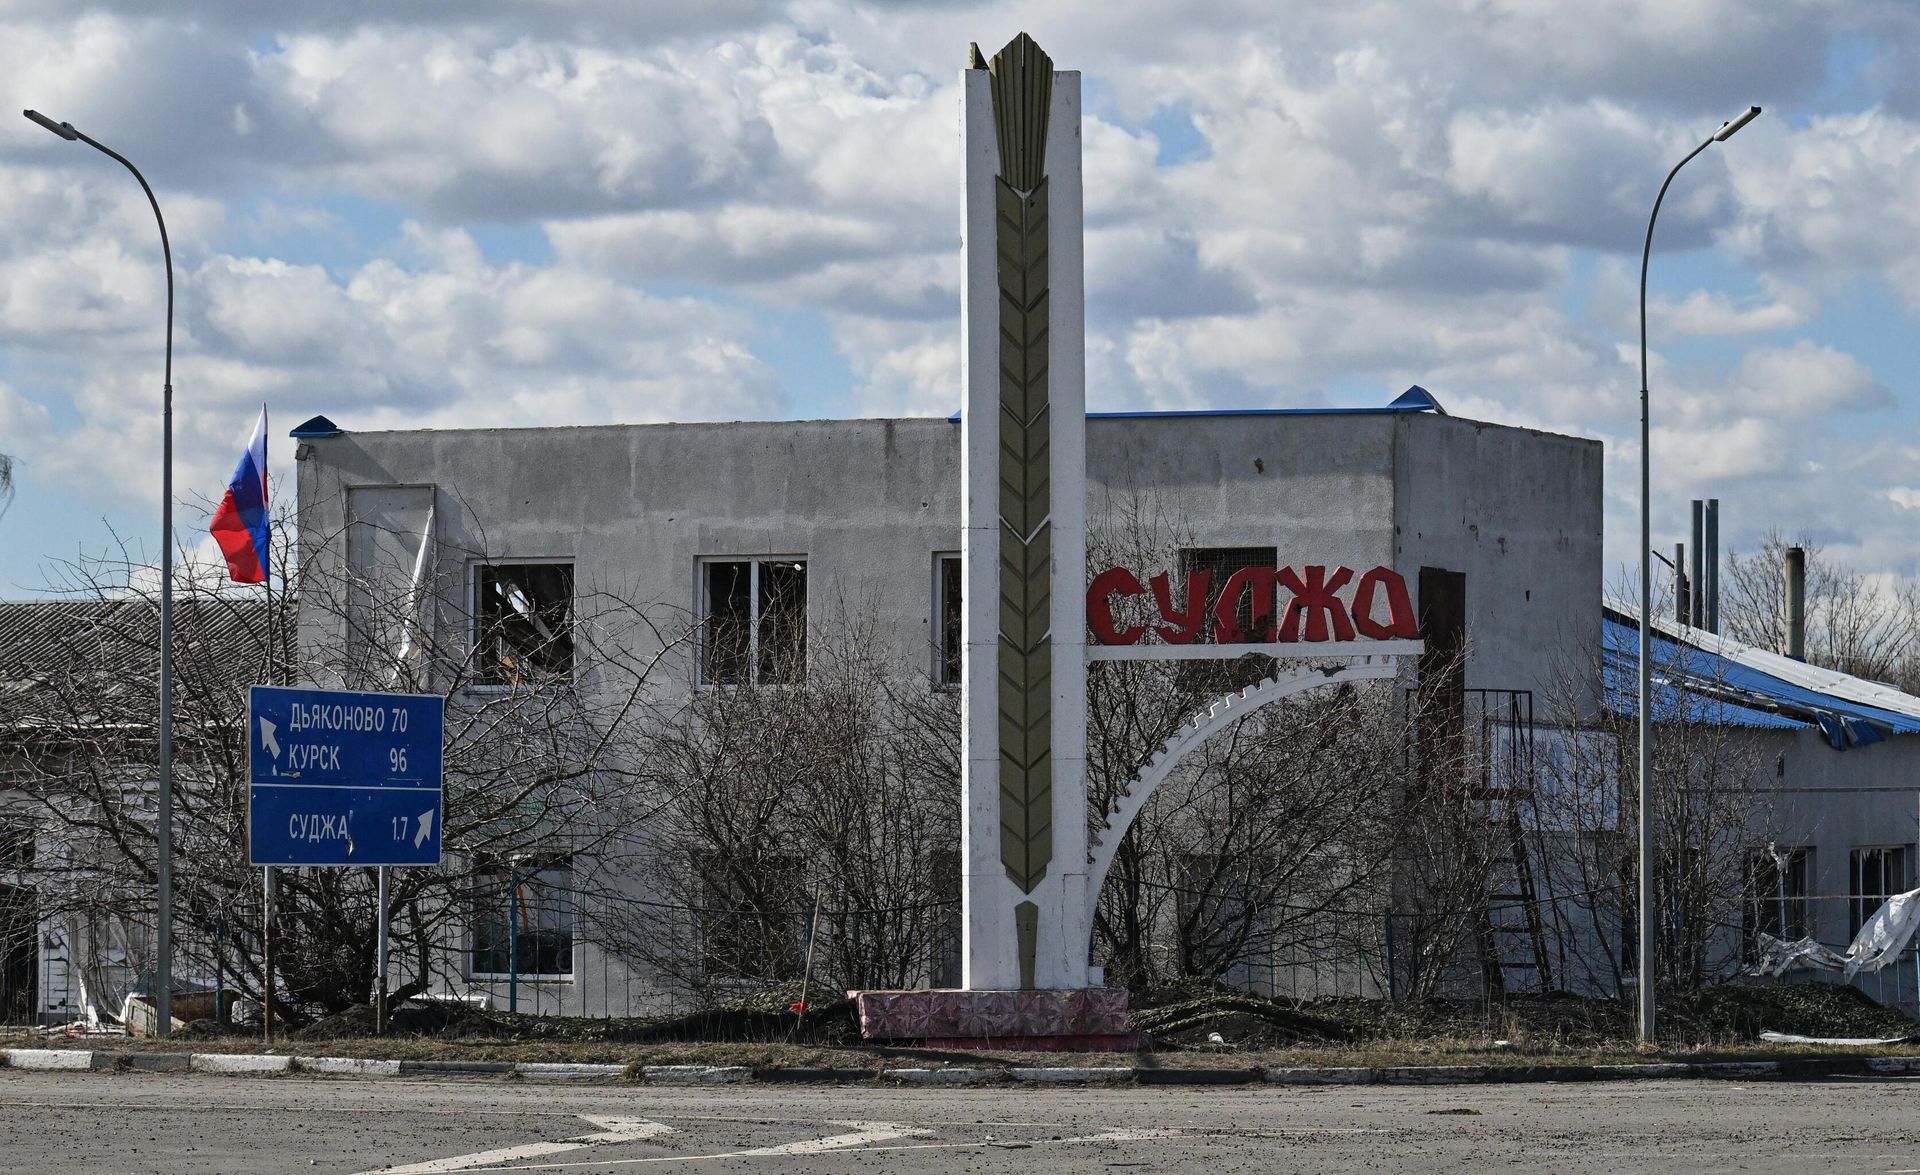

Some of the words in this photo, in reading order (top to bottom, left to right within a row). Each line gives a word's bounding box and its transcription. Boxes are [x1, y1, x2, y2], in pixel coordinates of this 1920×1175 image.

[1086, 566, 1419, 645] СУДЖА
[289, 703, 385, 732] ДЬЯКОНОВО
[391, 708, 408, 732] 70
[288, 744, 340, 770] КУРСК
[389, 748, 407, 772] 96
[289, 814, 348, 843] СУДЖА
[392, 816, 408, 841] 1.7
